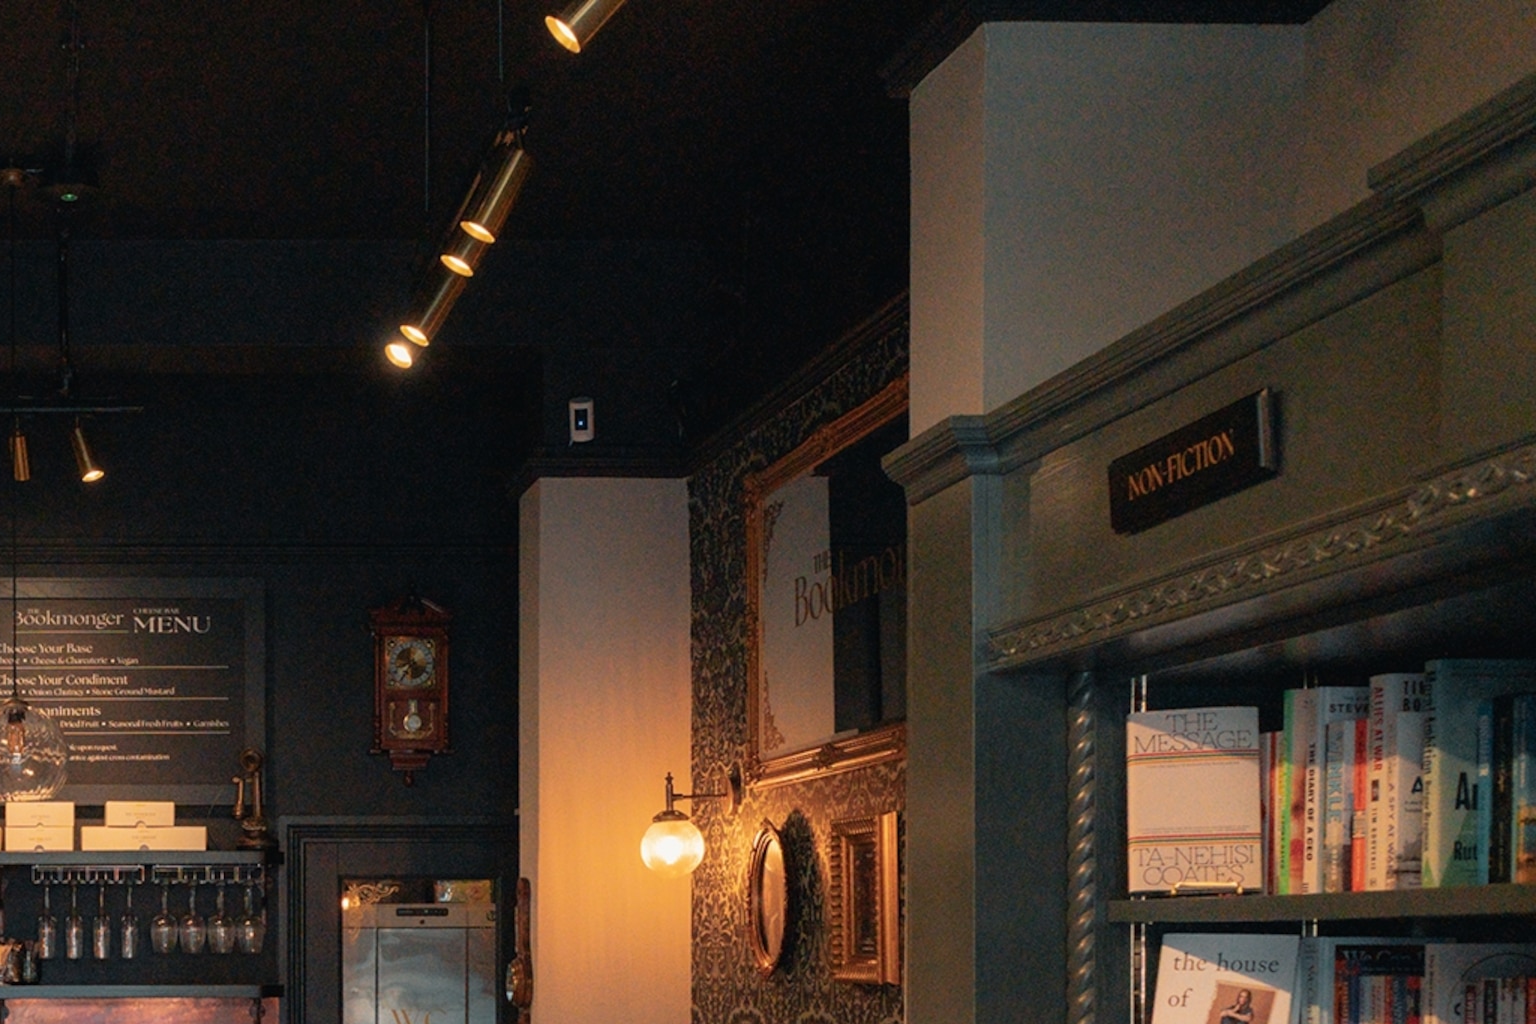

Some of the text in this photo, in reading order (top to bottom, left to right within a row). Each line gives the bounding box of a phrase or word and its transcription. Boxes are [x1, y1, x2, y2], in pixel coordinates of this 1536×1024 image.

[1128, 430, 1236, 501] NON-FICTION
[133, 615, 212, 633] MENU
[38, 643, 65, 654] Your
[66, 643, 93, 654] Base
[38, 674, 64, 685] Your
[65, 673, 129, 685] Condiment
[1166, 711, 1218, 733] THE
[1374, 686, 1385, 771] ALLIES AT WAR
[1134, 730, 1253, 754] MESSAGE
[1307, 769, 1315, 804] DIARY
[1307, 807, 1315, 821] OF
[1133, 844, 1254, 868] TA-NEHISI
[1306, 838, 1314, 861] CEO
[1143, 863, 1246, 886] COATES
[1173, 951, 1280, 974] the house
[1168, 987, 1193, 1008] of
